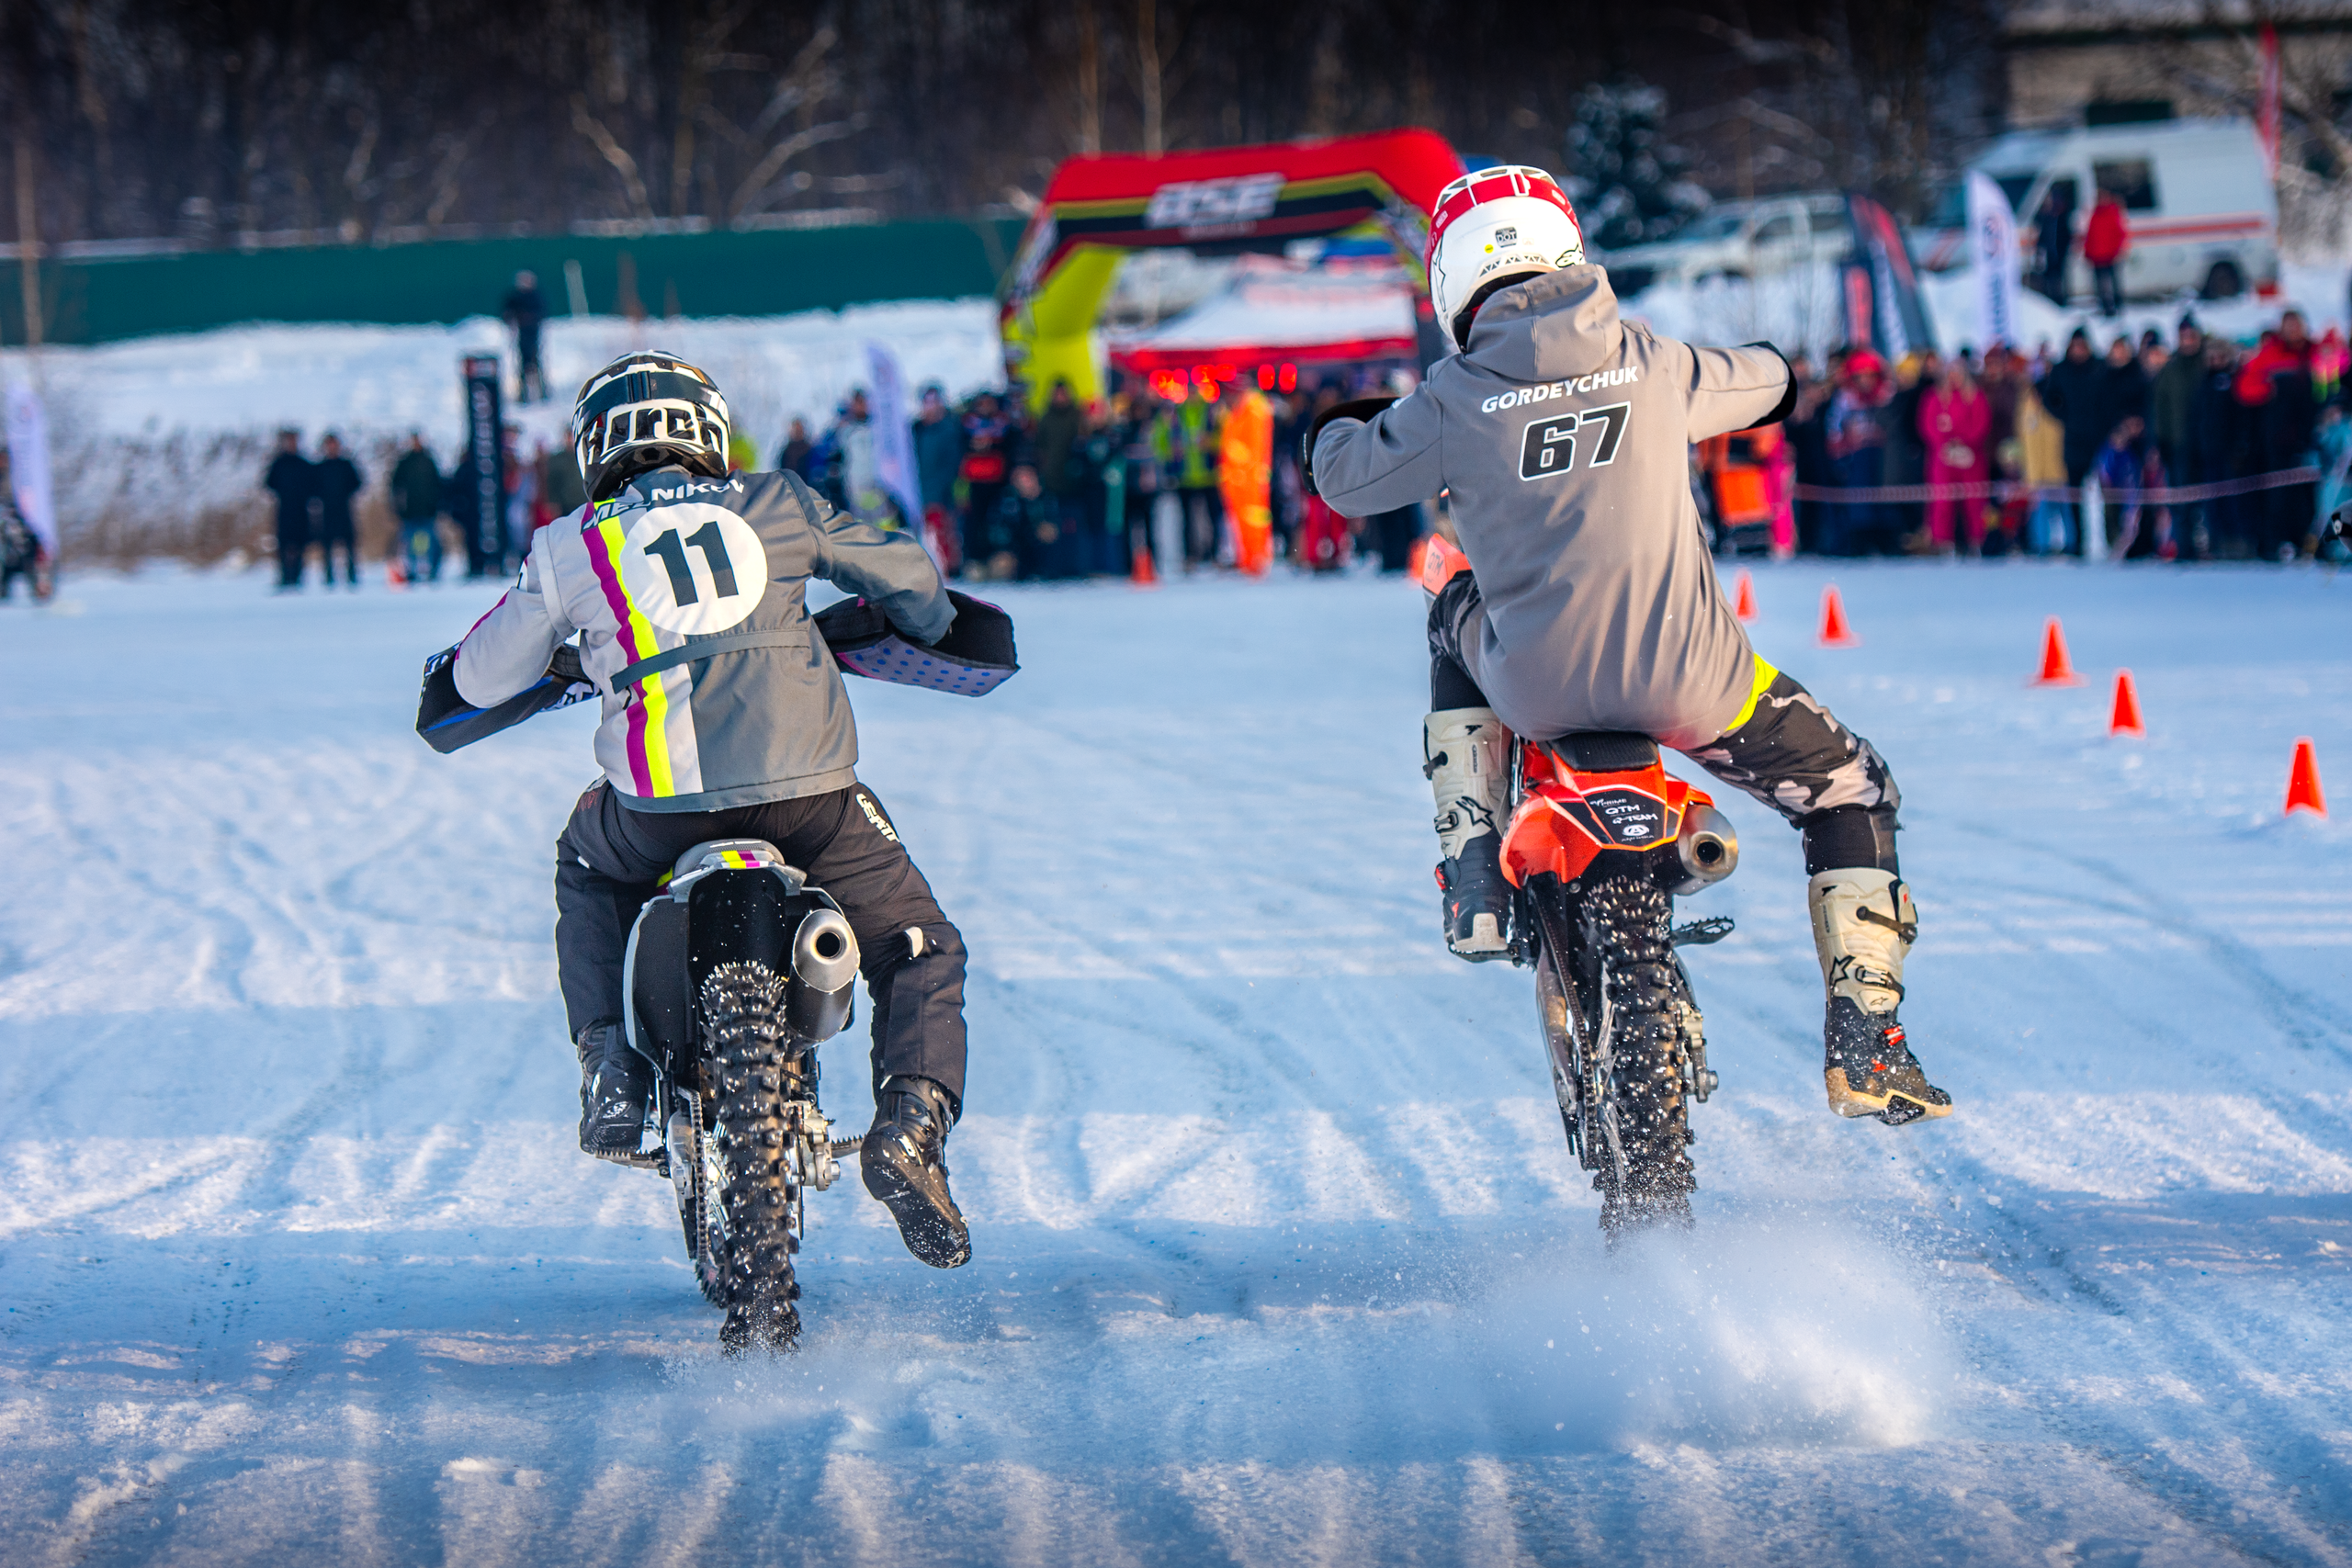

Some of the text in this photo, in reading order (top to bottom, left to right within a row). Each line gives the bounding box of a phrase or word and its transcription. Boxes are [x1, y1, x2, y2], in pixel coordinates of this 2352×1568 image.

[1497, 231, 1517, 243] DOT
[1481, 366, 1639, 413] GORDEYCHUK
[1518, 400, 1632, 482] 67
[643, 520, 740, 607] 11
[1605, 804, 1640, 815] QTM
